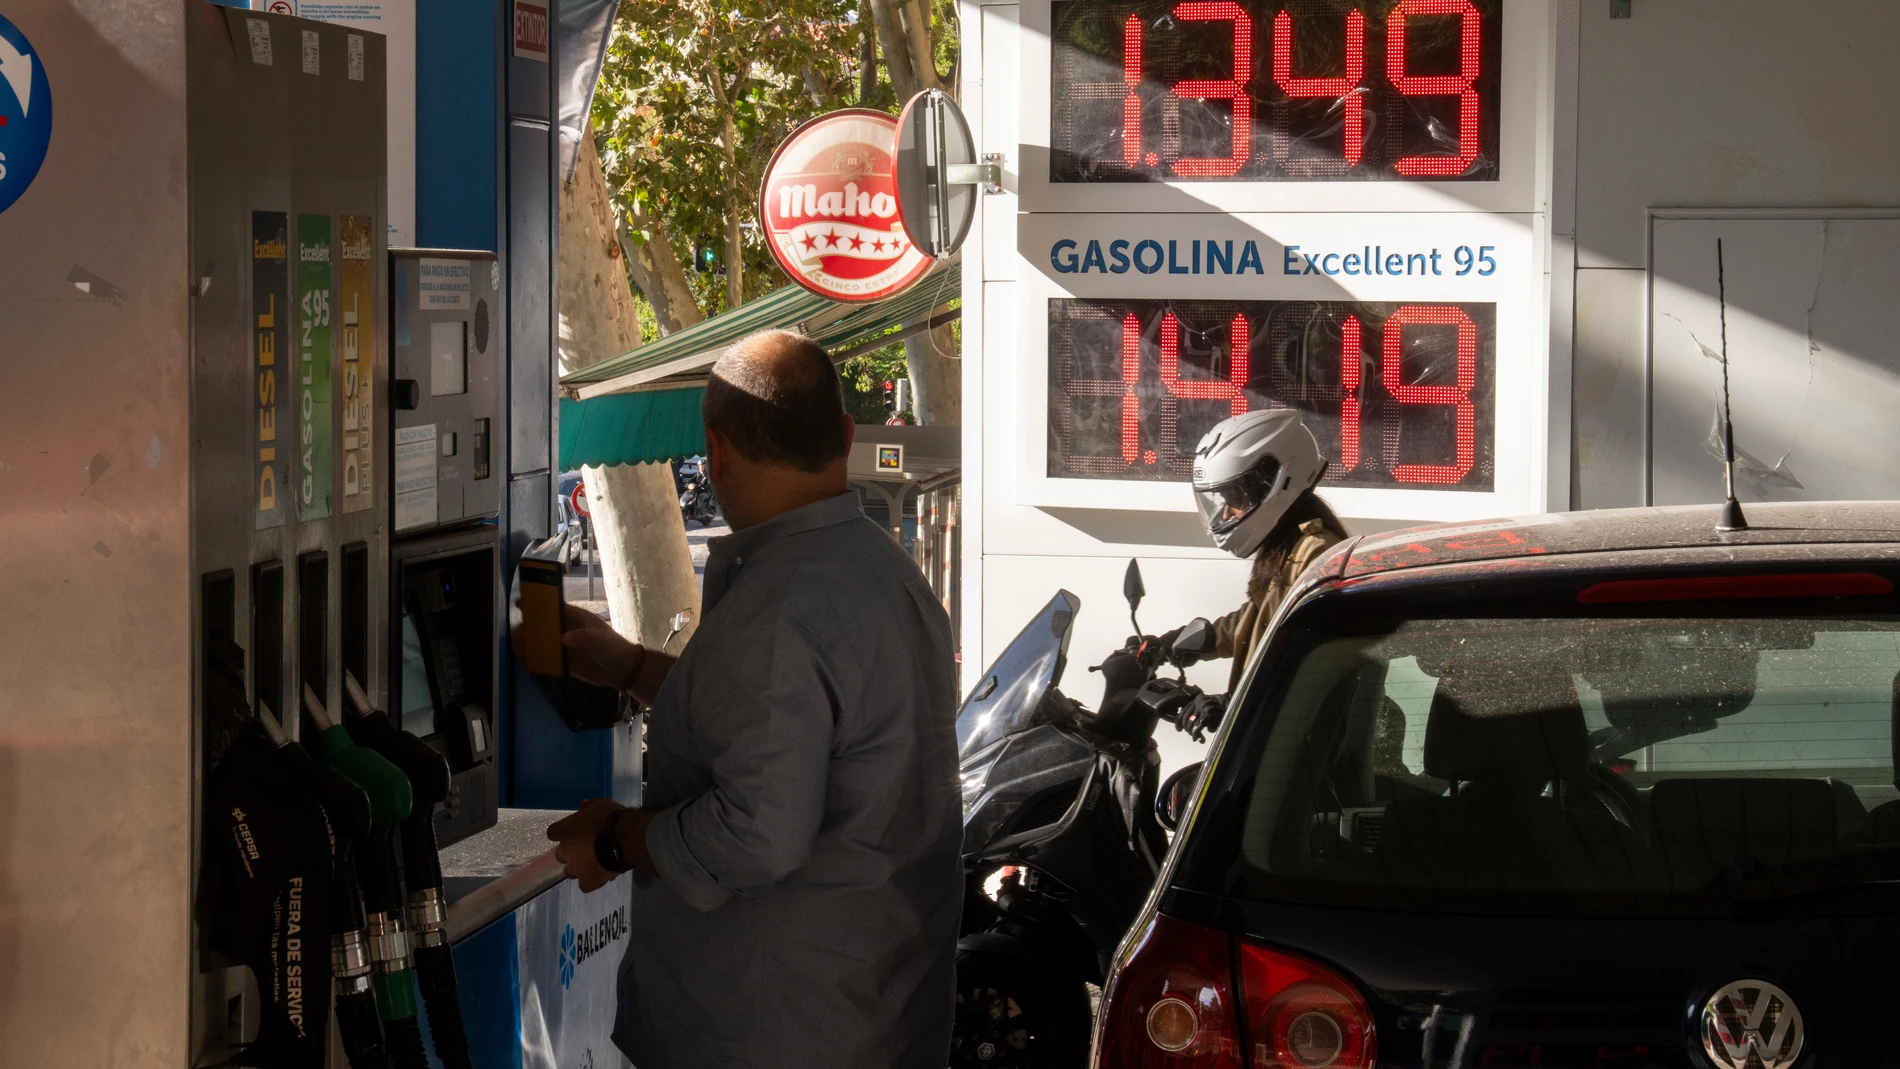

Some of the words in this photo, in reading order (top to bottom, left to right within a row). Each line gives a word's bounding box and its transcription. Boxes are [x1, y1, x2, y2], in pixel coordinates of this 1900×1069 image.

[516, 9, 546, 46] EXTINTOR
[1124, 0, 1480, 177] 1.349
[778, 182, 897, 219] Maho
[254, 239, 286, 259] Excellent
[300, 242, 330, 262] Excellent
[341, 240, 371, 260] Excellent
[1050, 239, 1265, 275] GASOLINA
[1284, 245, 1442, 276] Excellent
[1454, 245, 1497, 277] 95
[822, 278, 860, 291] CINCO
[313, 289, 330, 328] 95
[258, 293, 276, 511] DIESEL
[302, 290, 313, 505] GASOLINA
[344, 291, 359, 496] DIESEL
[1122, 305, 1476, 484] 1.419
[238, 823, 260, 860] CEPSA
[287, 876, 303, 936] FUERA
[271, 932, 280, 949] las
[286, 938, 302, 962] DE
[576, 905, 628, 965] BALLENOIL
[286, 965, 306, 1039] SERVIC
